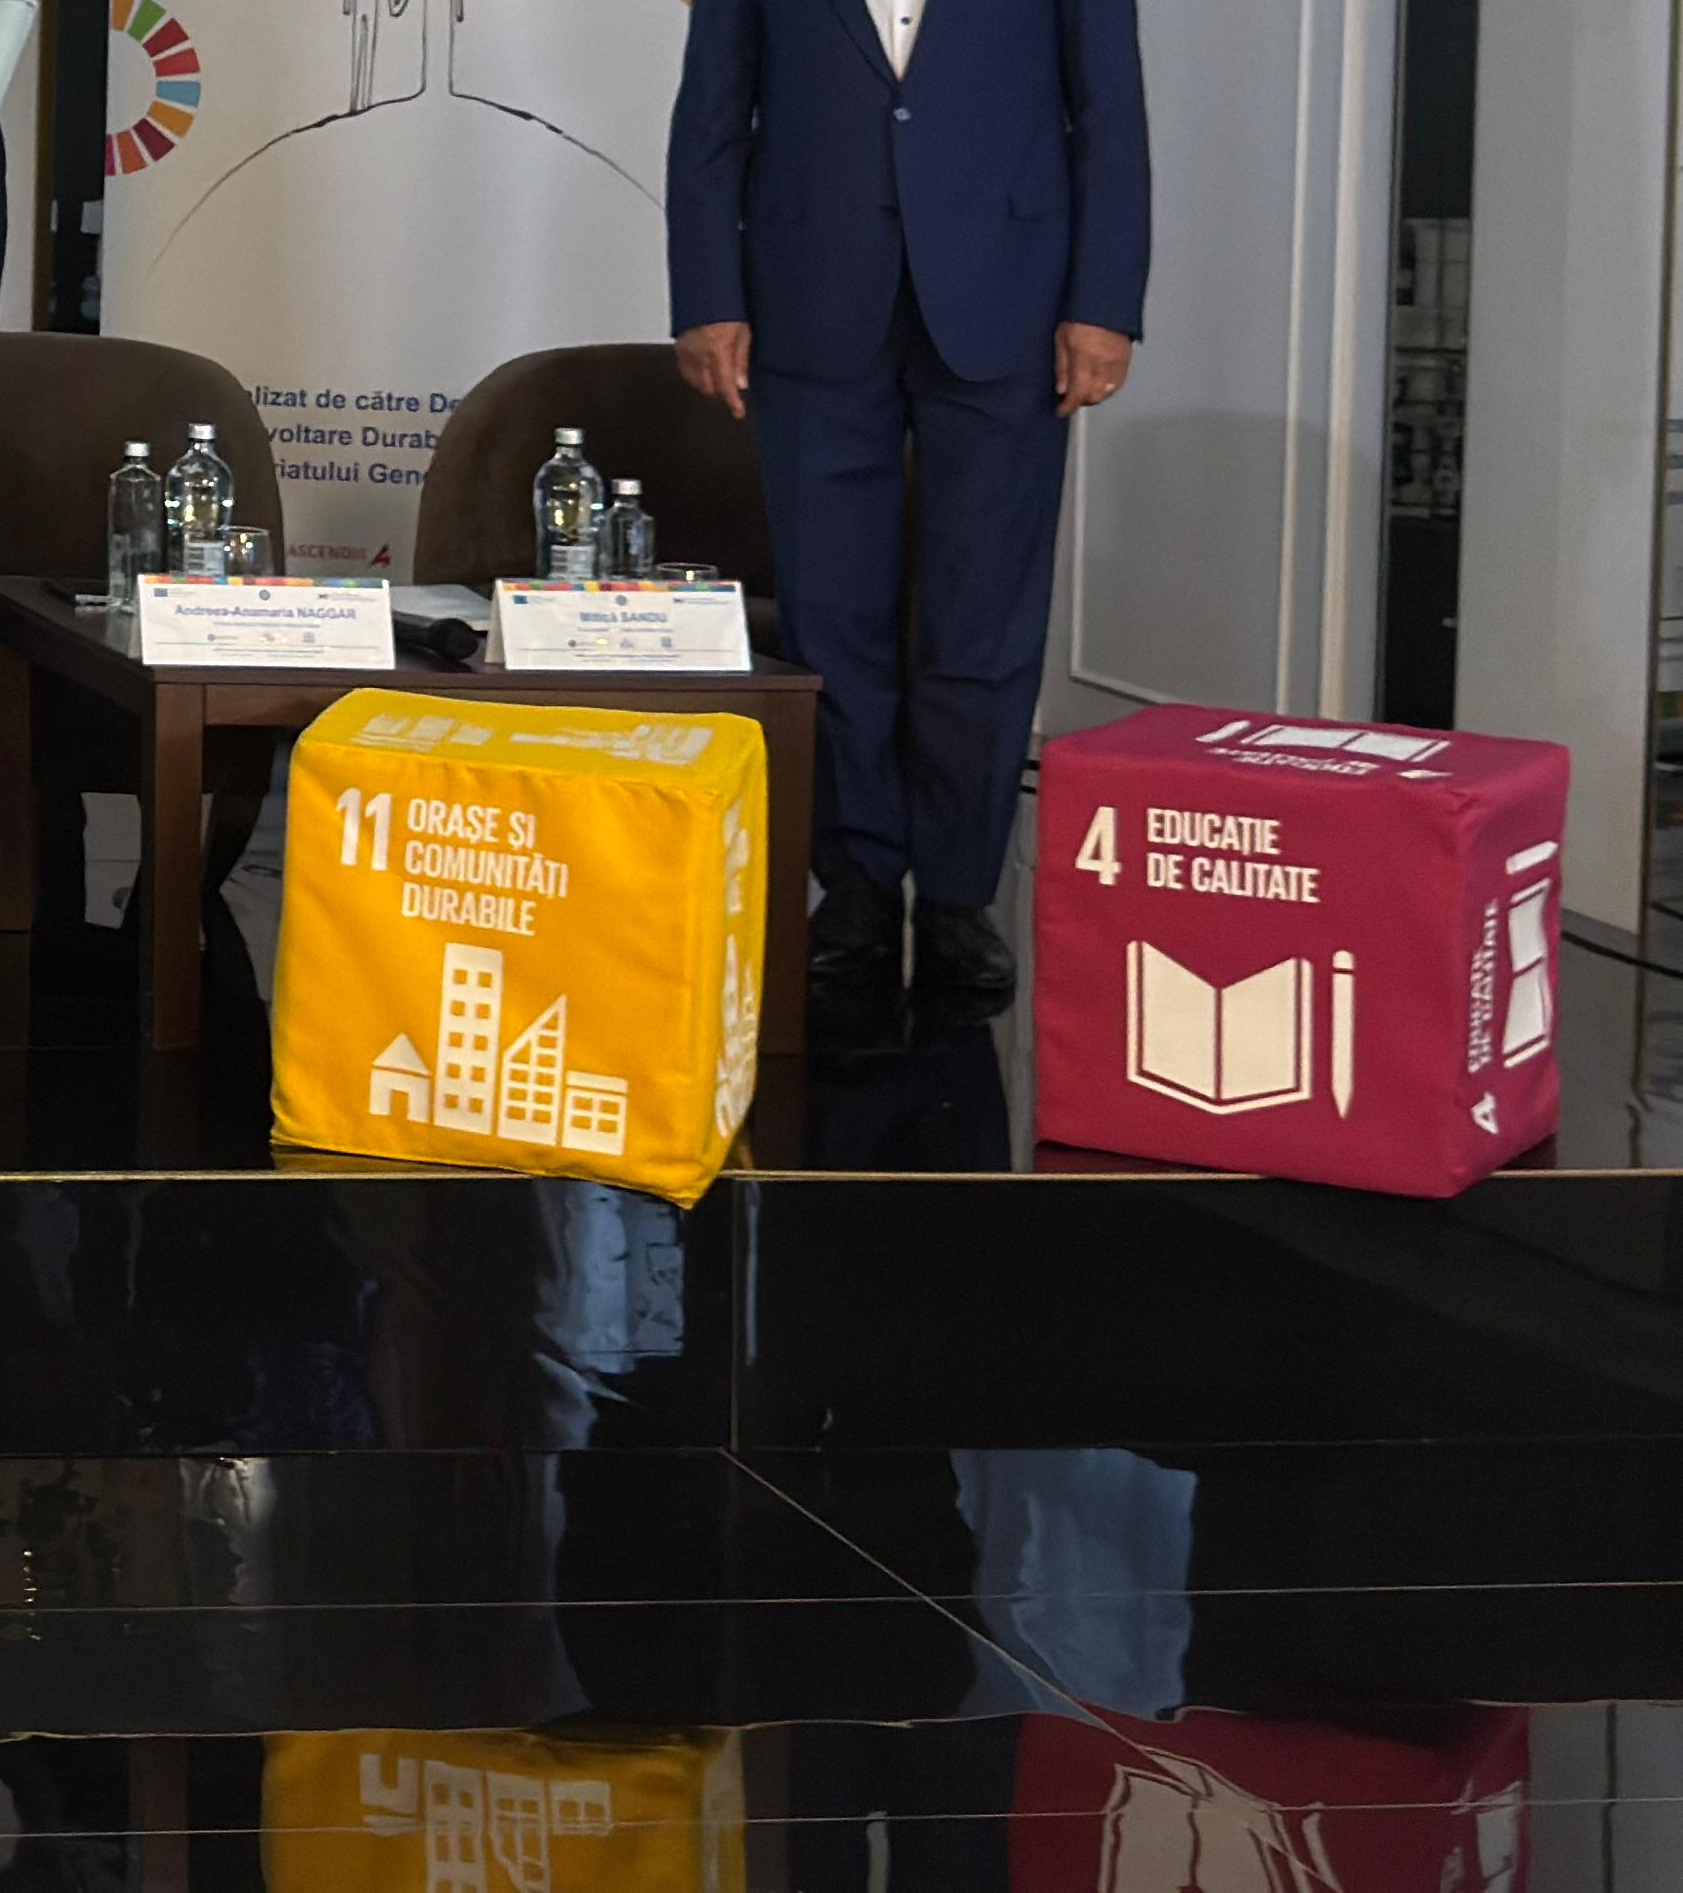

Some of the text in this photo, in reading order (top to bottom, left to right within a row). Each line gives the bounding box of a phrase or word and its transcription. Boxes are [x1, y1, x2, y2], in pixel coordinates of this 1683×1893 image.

[251, 385, 307, 408] lizat
[315, 389, 346, 409] de
[355, 390, 420, 412] către
[269, 424, 442, 450] voltare Durab
[336, 787, 393, 872] 11
[407, 797, 536, 848] ORAȘE ȘI
[1075, 806, 1122, 886] 4
[1147, 807, 1281, 858] EDUCAȚIE
[405, 840, 568, 900] COMUNITĂȚI
[1147, 852, 1321, 904] DE CALITATE
[401, 882, 536, 937] DURABILE
